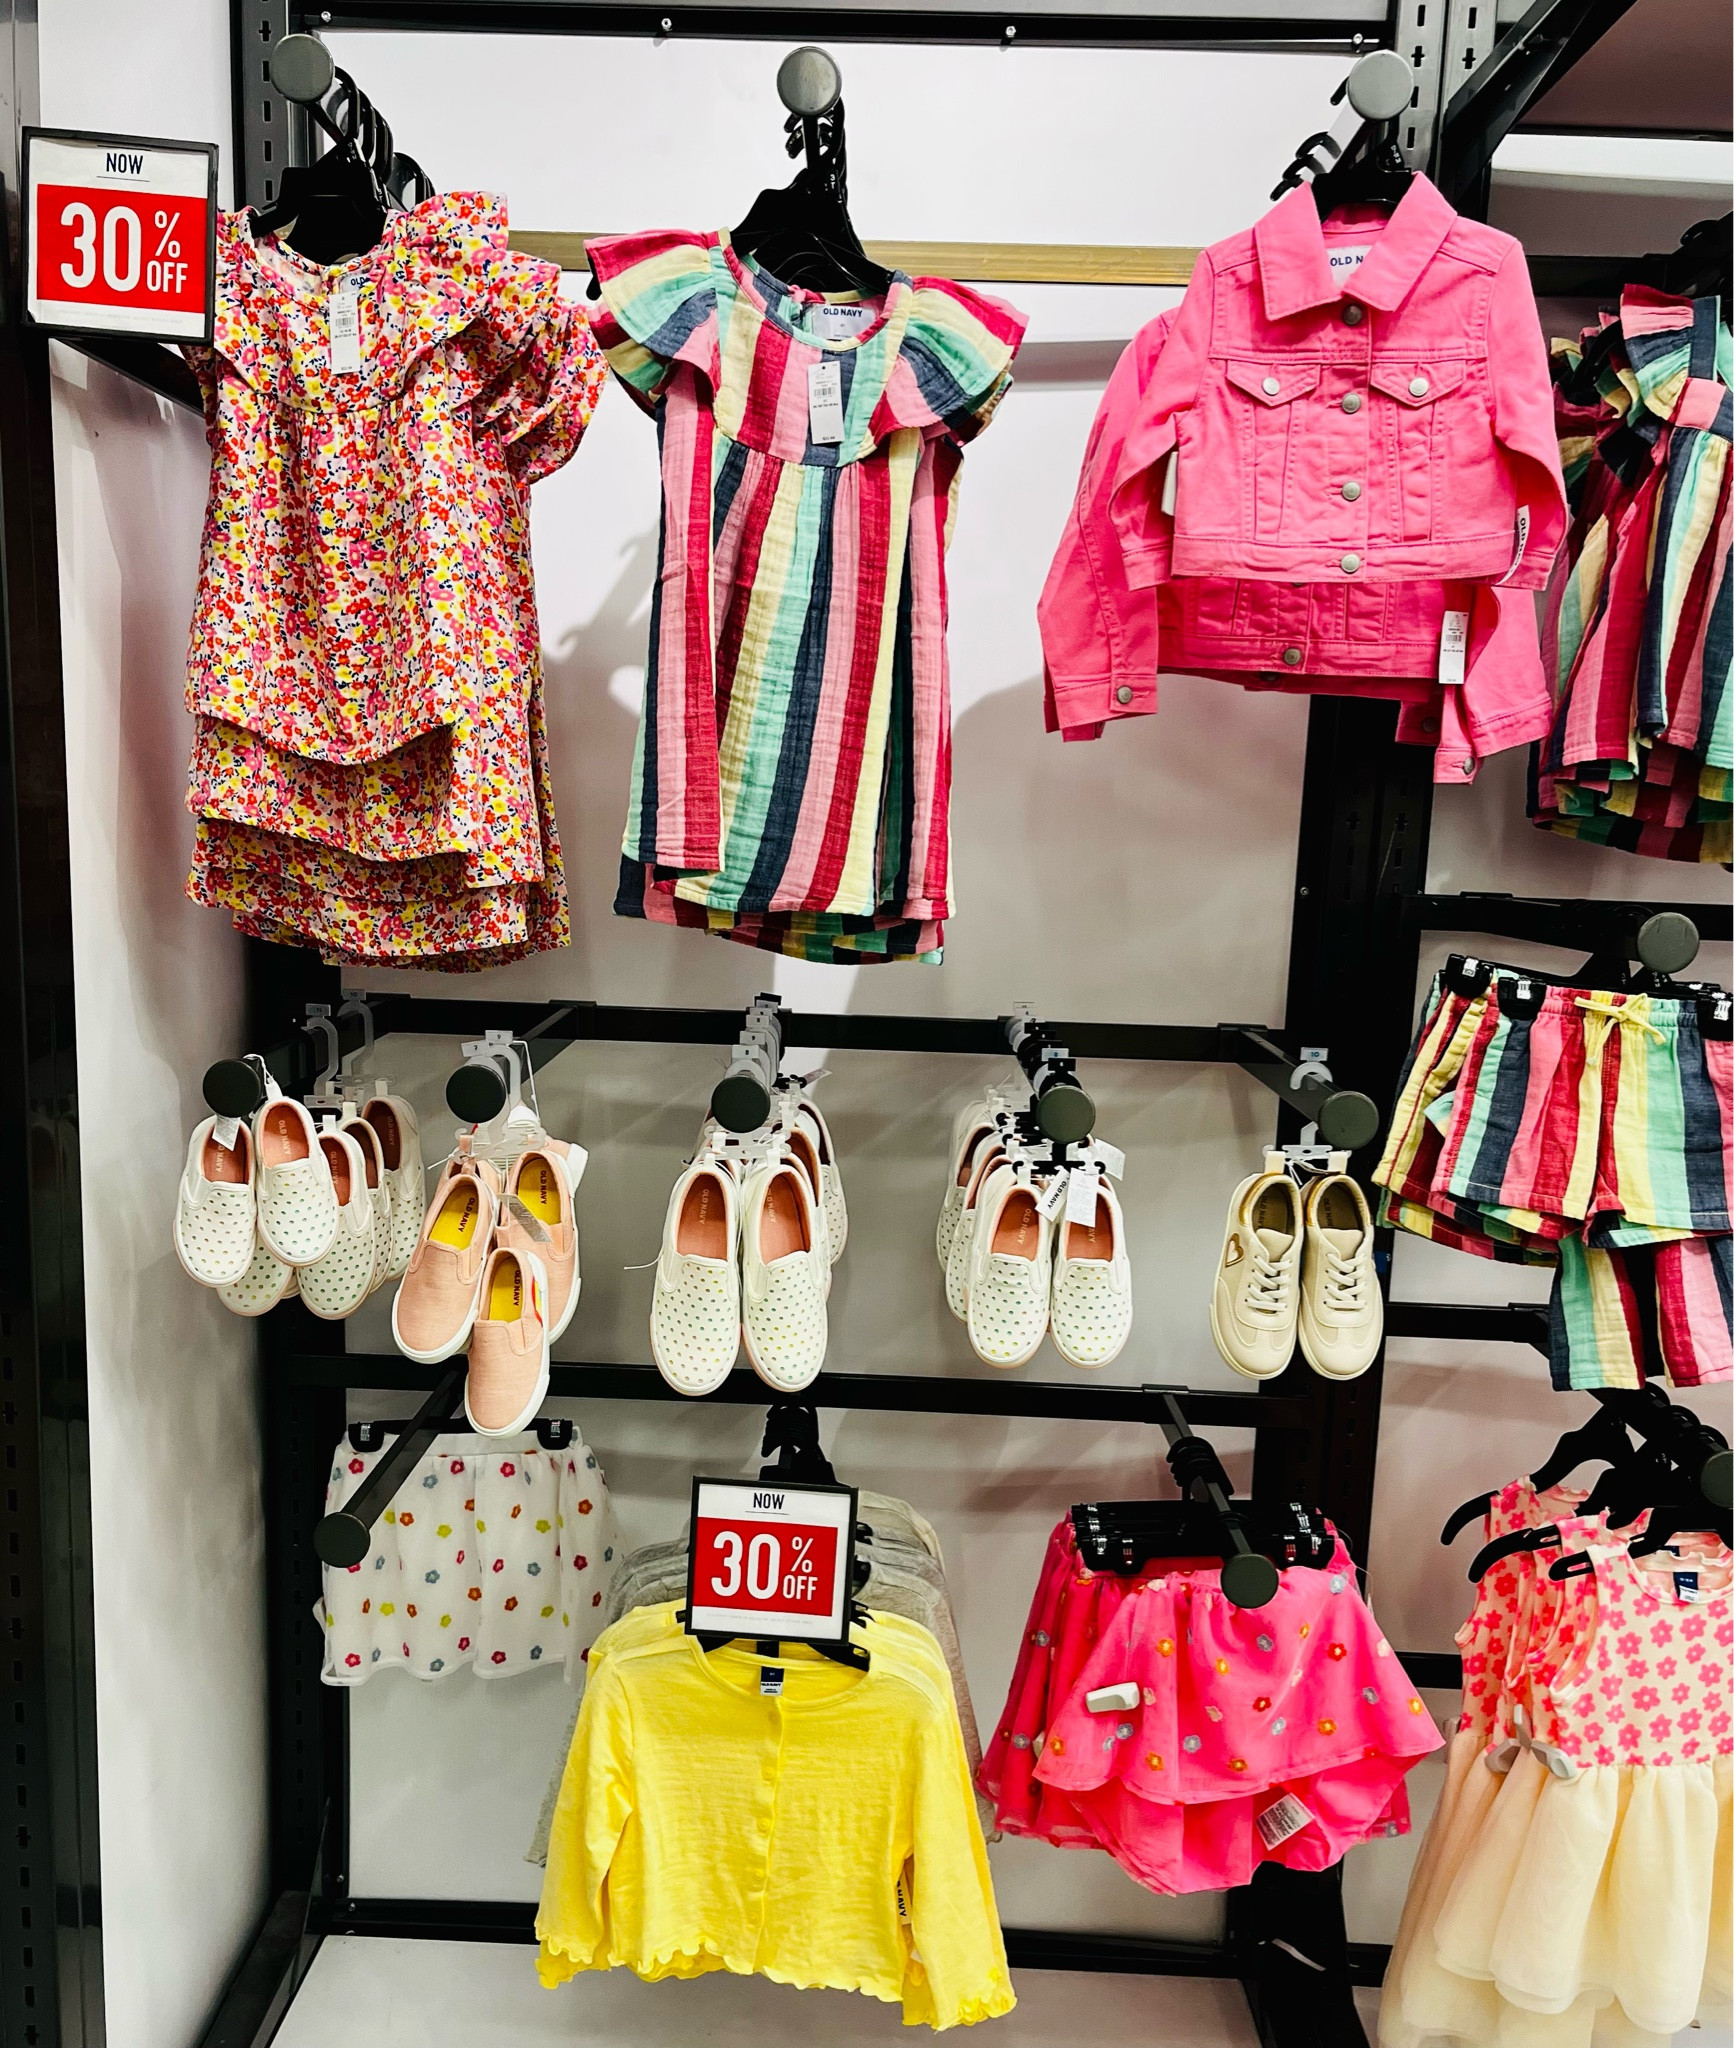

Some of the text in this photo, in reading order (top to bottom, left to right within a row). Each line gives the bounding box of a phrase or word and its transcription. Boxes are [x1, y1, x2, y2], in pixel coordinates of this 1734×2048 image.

[105, 152, 144, 175] NOW
[1330, 255, 1353, 267] OLD
[146, 260, 189, 294] OFF
[823, 307, 863, 318] OLD NAVY
[278, 1120, 292, 1155] OLD NAVY
[540, 1184, 548, 1205] NAVY
[698, 1188, 710, 1225] OLD NAVY
[1047, 1181, 1067, 1209] OLD NAVY
[458, 1197, 476, 1233] OLD NAVY
[1017, 1208, 1032, 1245] OLD NAVY
[753, 1492, 786, 1510] NOW
[782, 1574, 819, 1601] OFF
